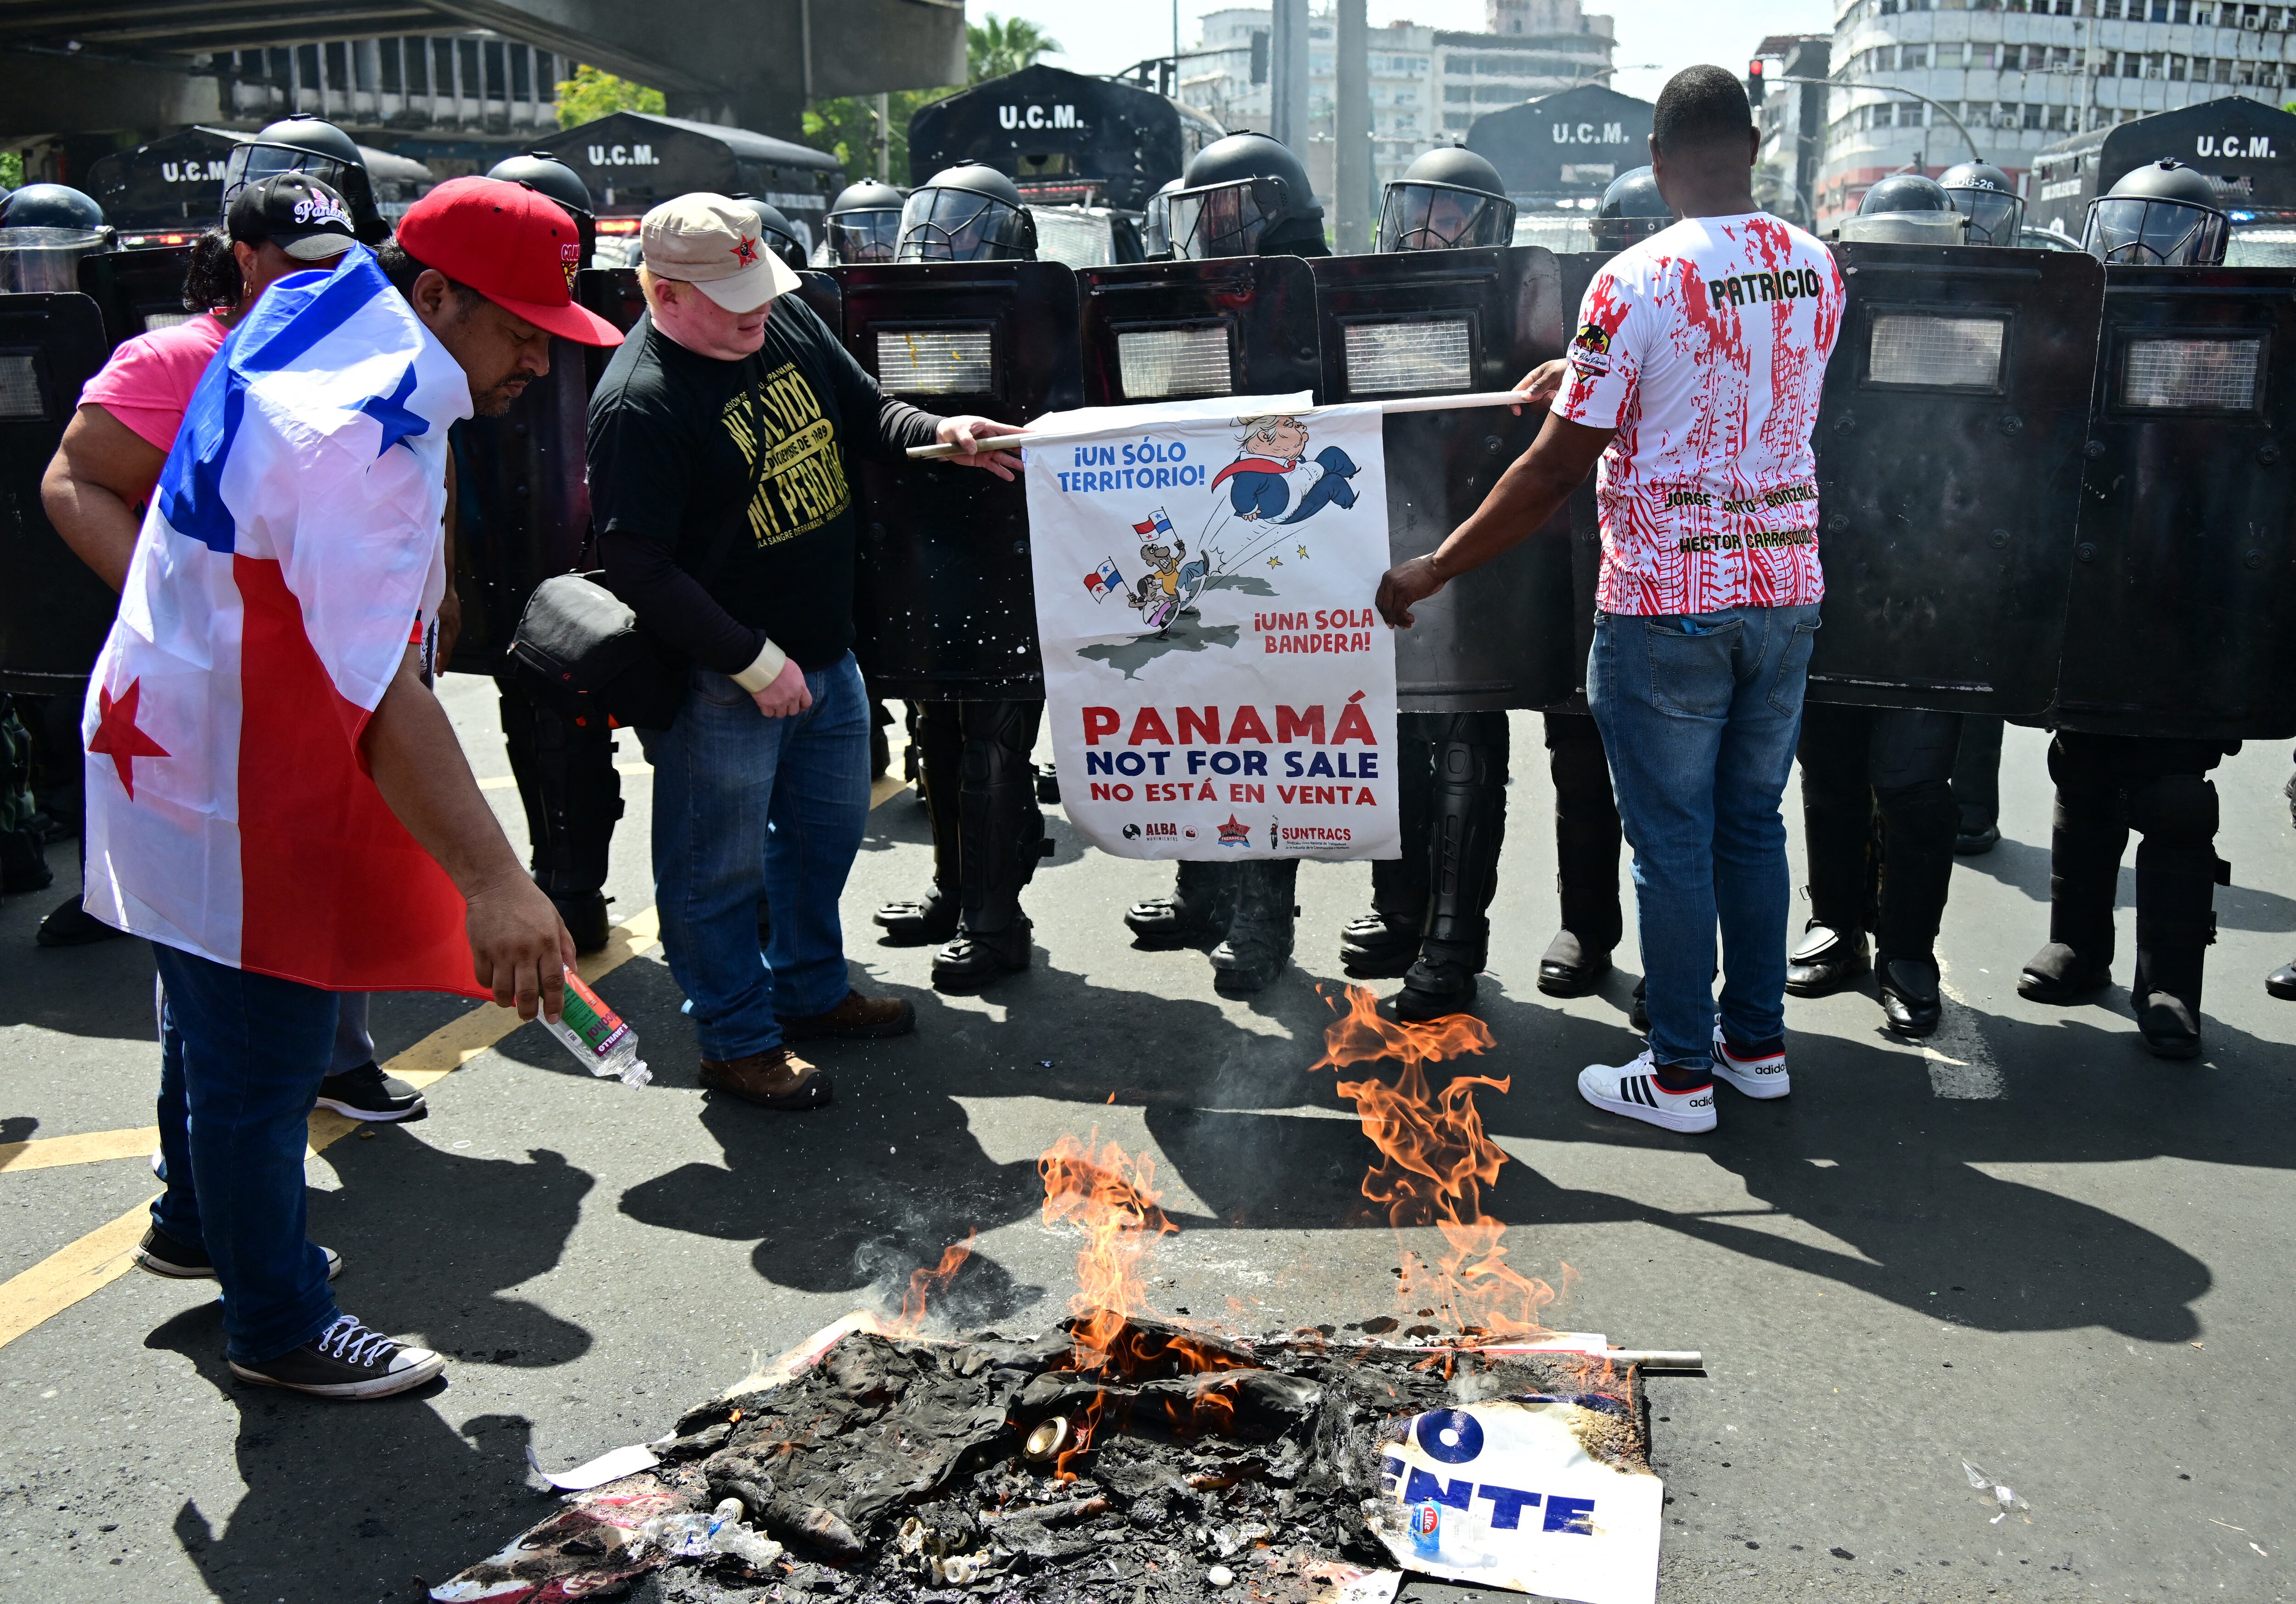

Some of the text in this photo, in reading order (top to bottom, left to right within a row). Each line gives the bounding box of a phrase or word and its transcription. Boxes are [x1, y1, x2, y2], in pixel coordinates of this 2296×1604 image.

[999, 105, 1084, 129] U.C.M.
[1553, 122, 1630, 144] U.C.M.
[588, 145, 660, 166] U.C.M.
[2197, 135, 2276, 158] U.C.M.
[1708, 268, 1820, 310] PATRICIO
[796, 434, 812, 451] DE
[1075, 436, 1186, 467] ¡UN SÓLO
[1058, 465, 1205, 493] TERRITORIO!
[1665, 491, 1712, 508] JORGE
[767, 529, 794, 546] SANGRE
[1679, 534, 1742, 554] HECTOR
[1255, 608, 1374, 632] ¡UNA SOLA
[1265, 631, 1370, 654] BANDERA!
[1082, 690, 1378, 746] PANAMÁ
[1086, 750, 1379, 778] NOT FOR SALE
[1090, 777, 1377, 806] NO ESTÁ EN VENTA
[1146, 823, 1177, 835] ALBA
[1282, 827, 1351, 841] SUNTRACS
[598, 1026, 625, 1052] JAVILLO
[1424, 1510, 1434, 1531] Like
